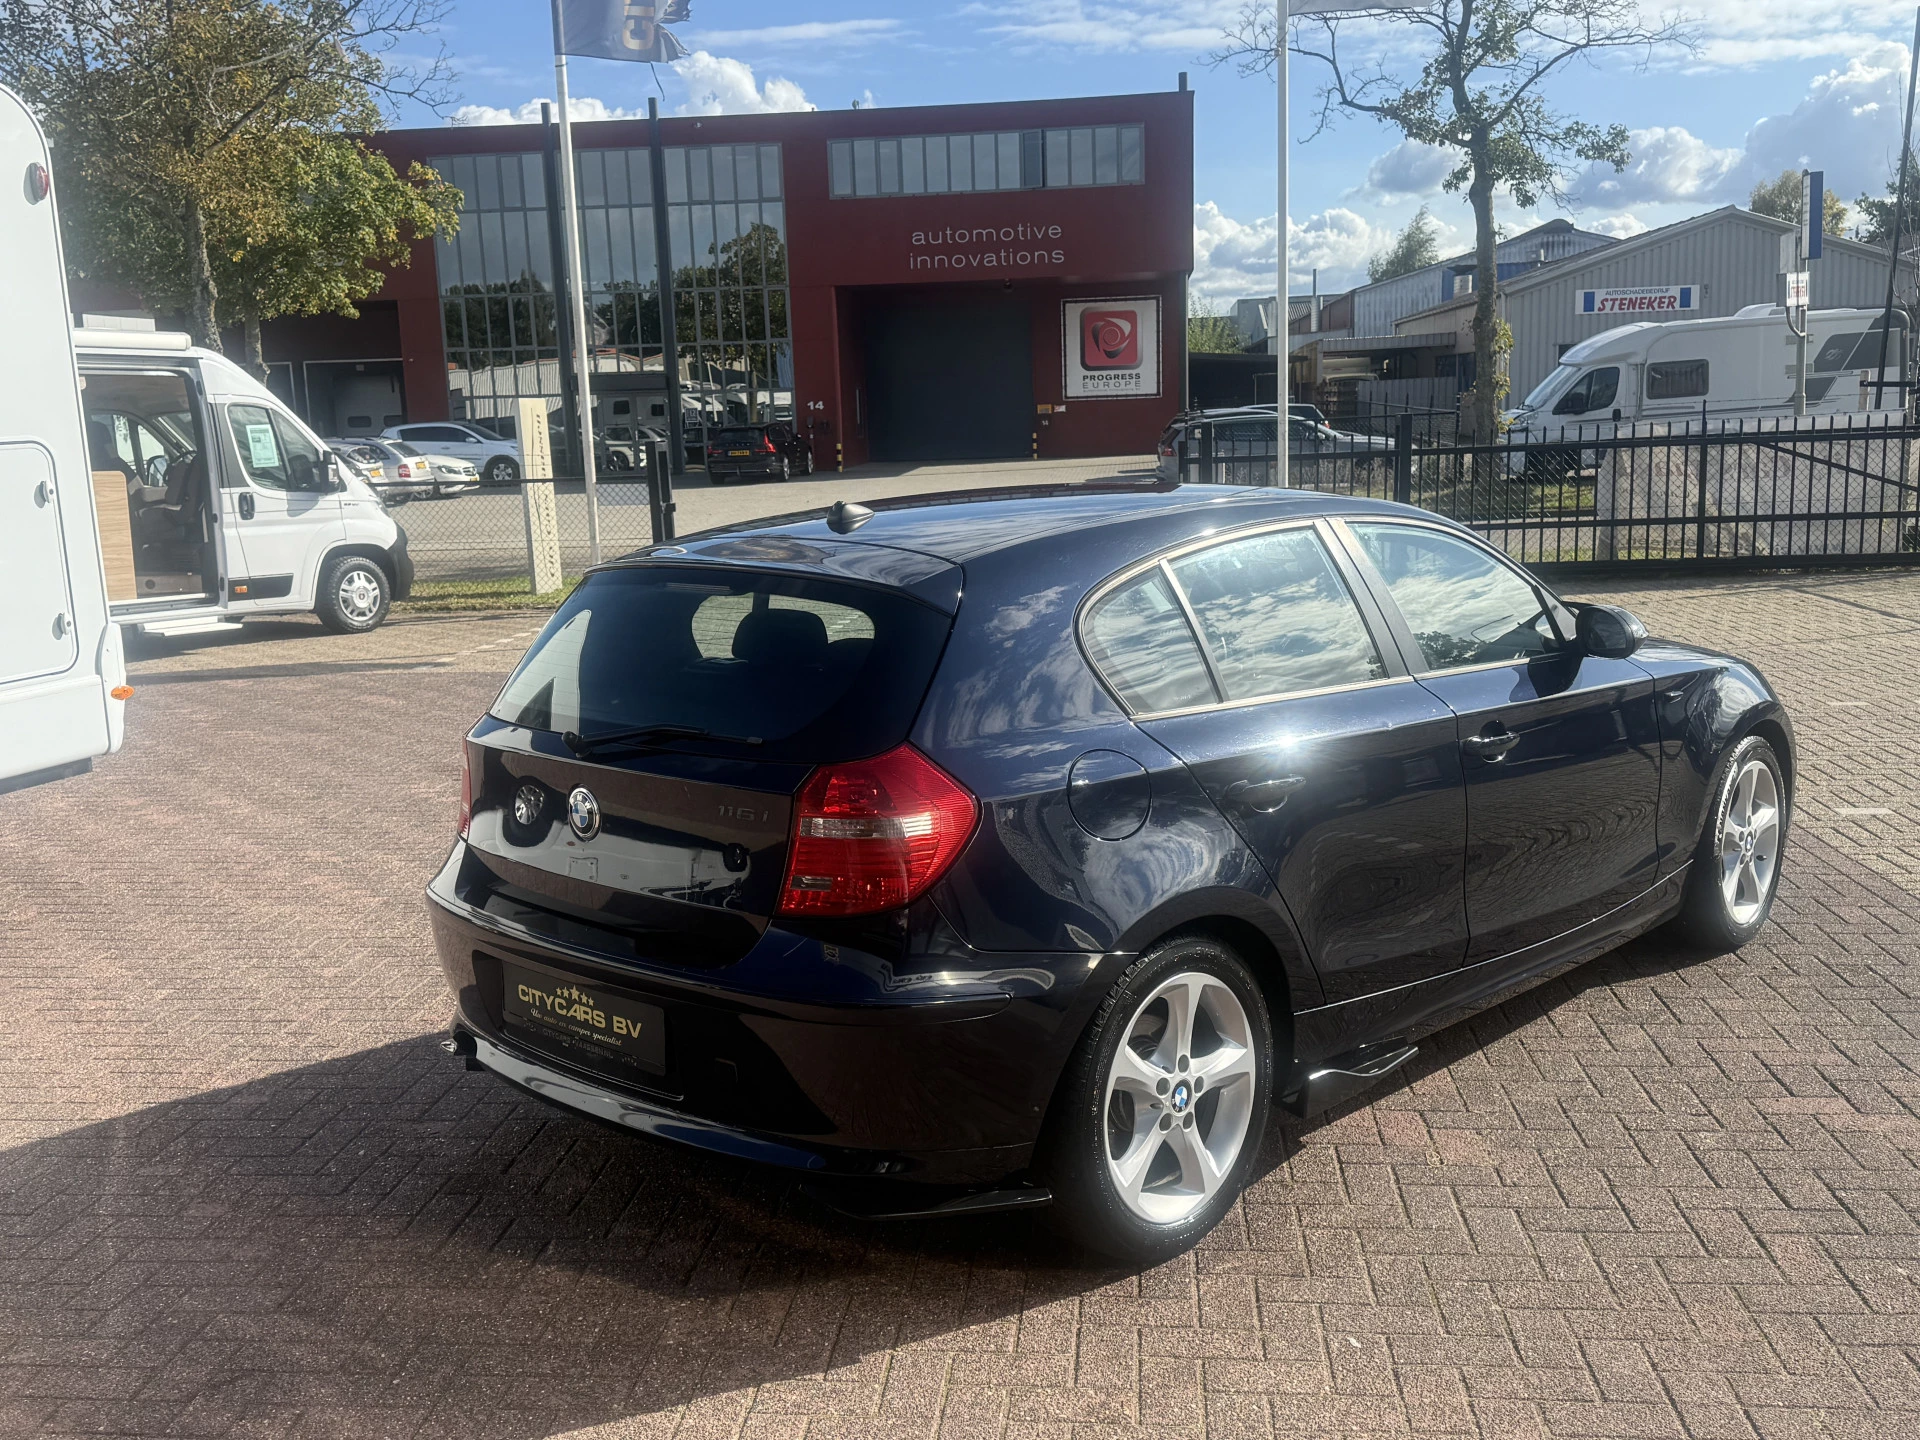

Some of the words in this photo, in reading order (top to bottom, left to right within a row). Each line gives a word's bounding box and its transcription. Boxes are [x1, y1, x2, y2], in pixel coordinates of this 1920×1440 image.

[622, 0, 655, 50] CI
[911, 223, 1062, 245] automotive
[909, 248, 1065, 270] innovations
[1605, 287, 1671, 296] AUTOSCHADEBEDRIJF
[1597, 295, 1678, 312] STENEKER
[1082, 372, 1141, 382] PROGRESS
[1082, 380, 1141, 390] EUROPE
[807, 400, 825, 411] 14
[518, 984, 606, 1029] CITYCARS
[612, 1015, 642, 1039] BV
[568, 1024, 591, 1037] camper
[592, 1031, 623, 1047] specialist
